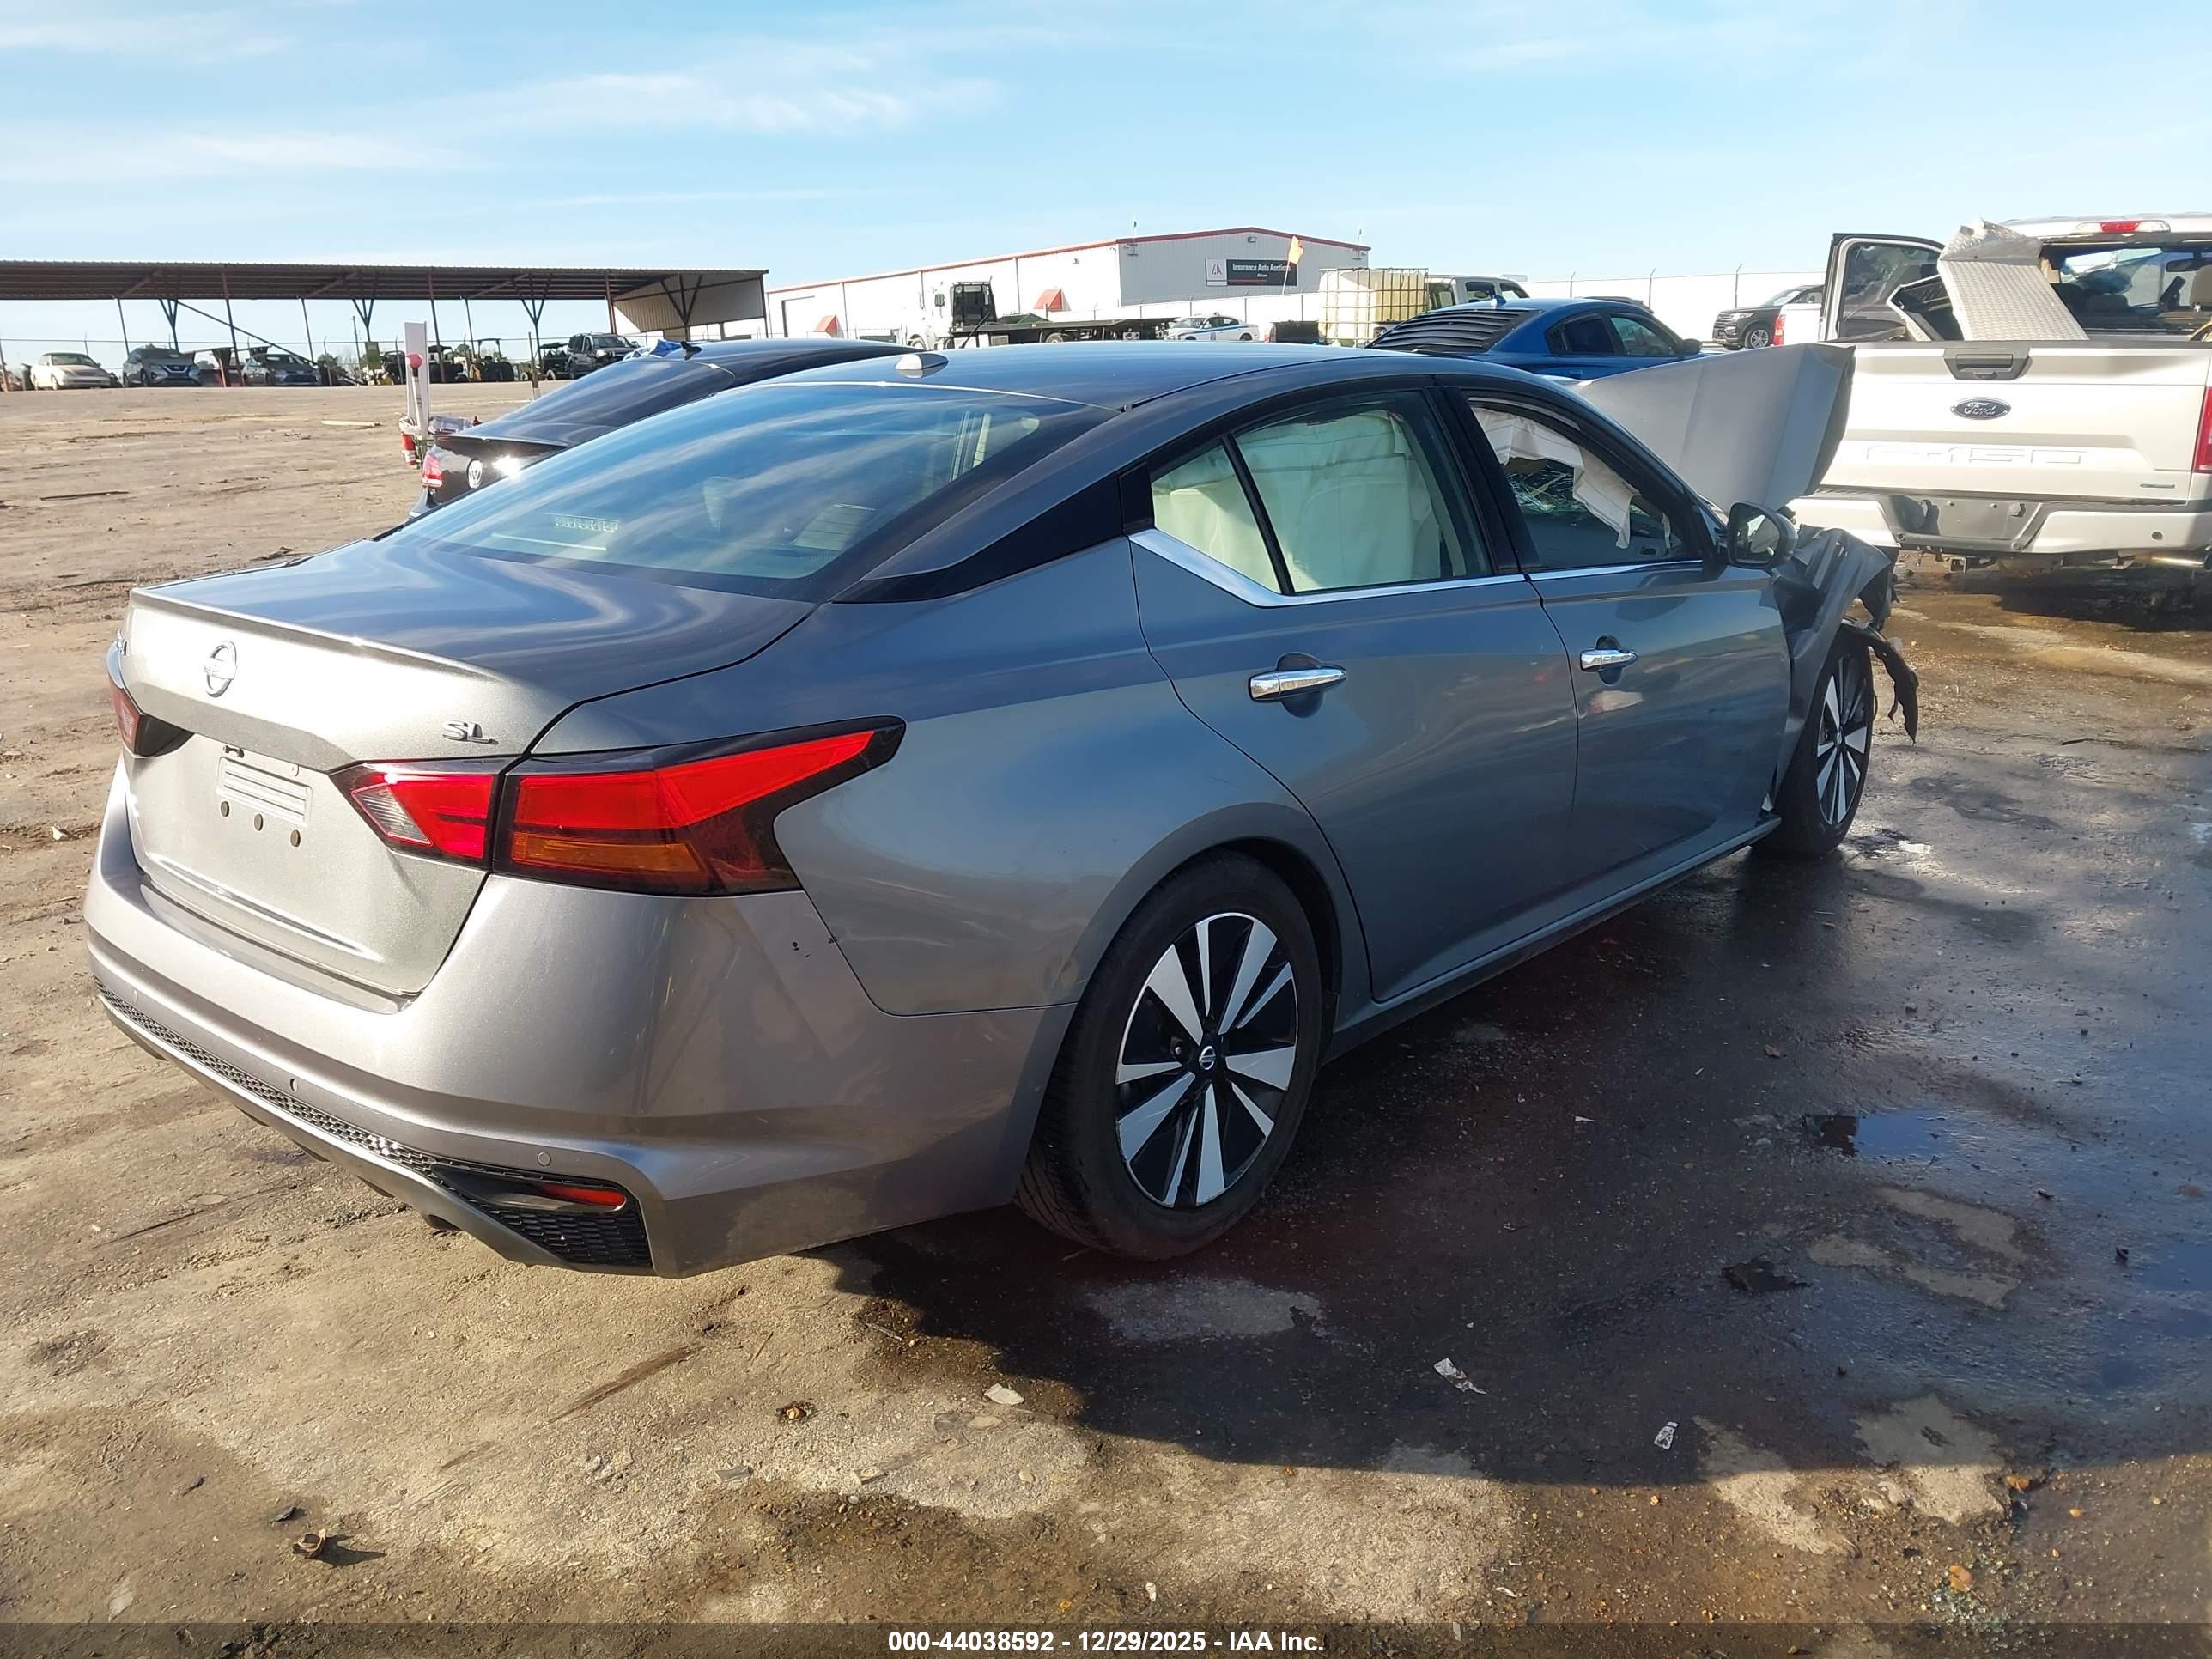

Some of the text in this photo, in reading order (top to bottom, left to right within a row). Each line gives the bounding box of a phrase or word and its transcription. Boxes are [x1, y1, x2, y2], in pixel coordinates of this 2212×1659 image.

[1232, 263, 1256, 271] Insurance
[1258, 263, 1269, 271] Auto
[1964, 401, 1997, 416] Ford
[441, 721, 499, 745] SL
